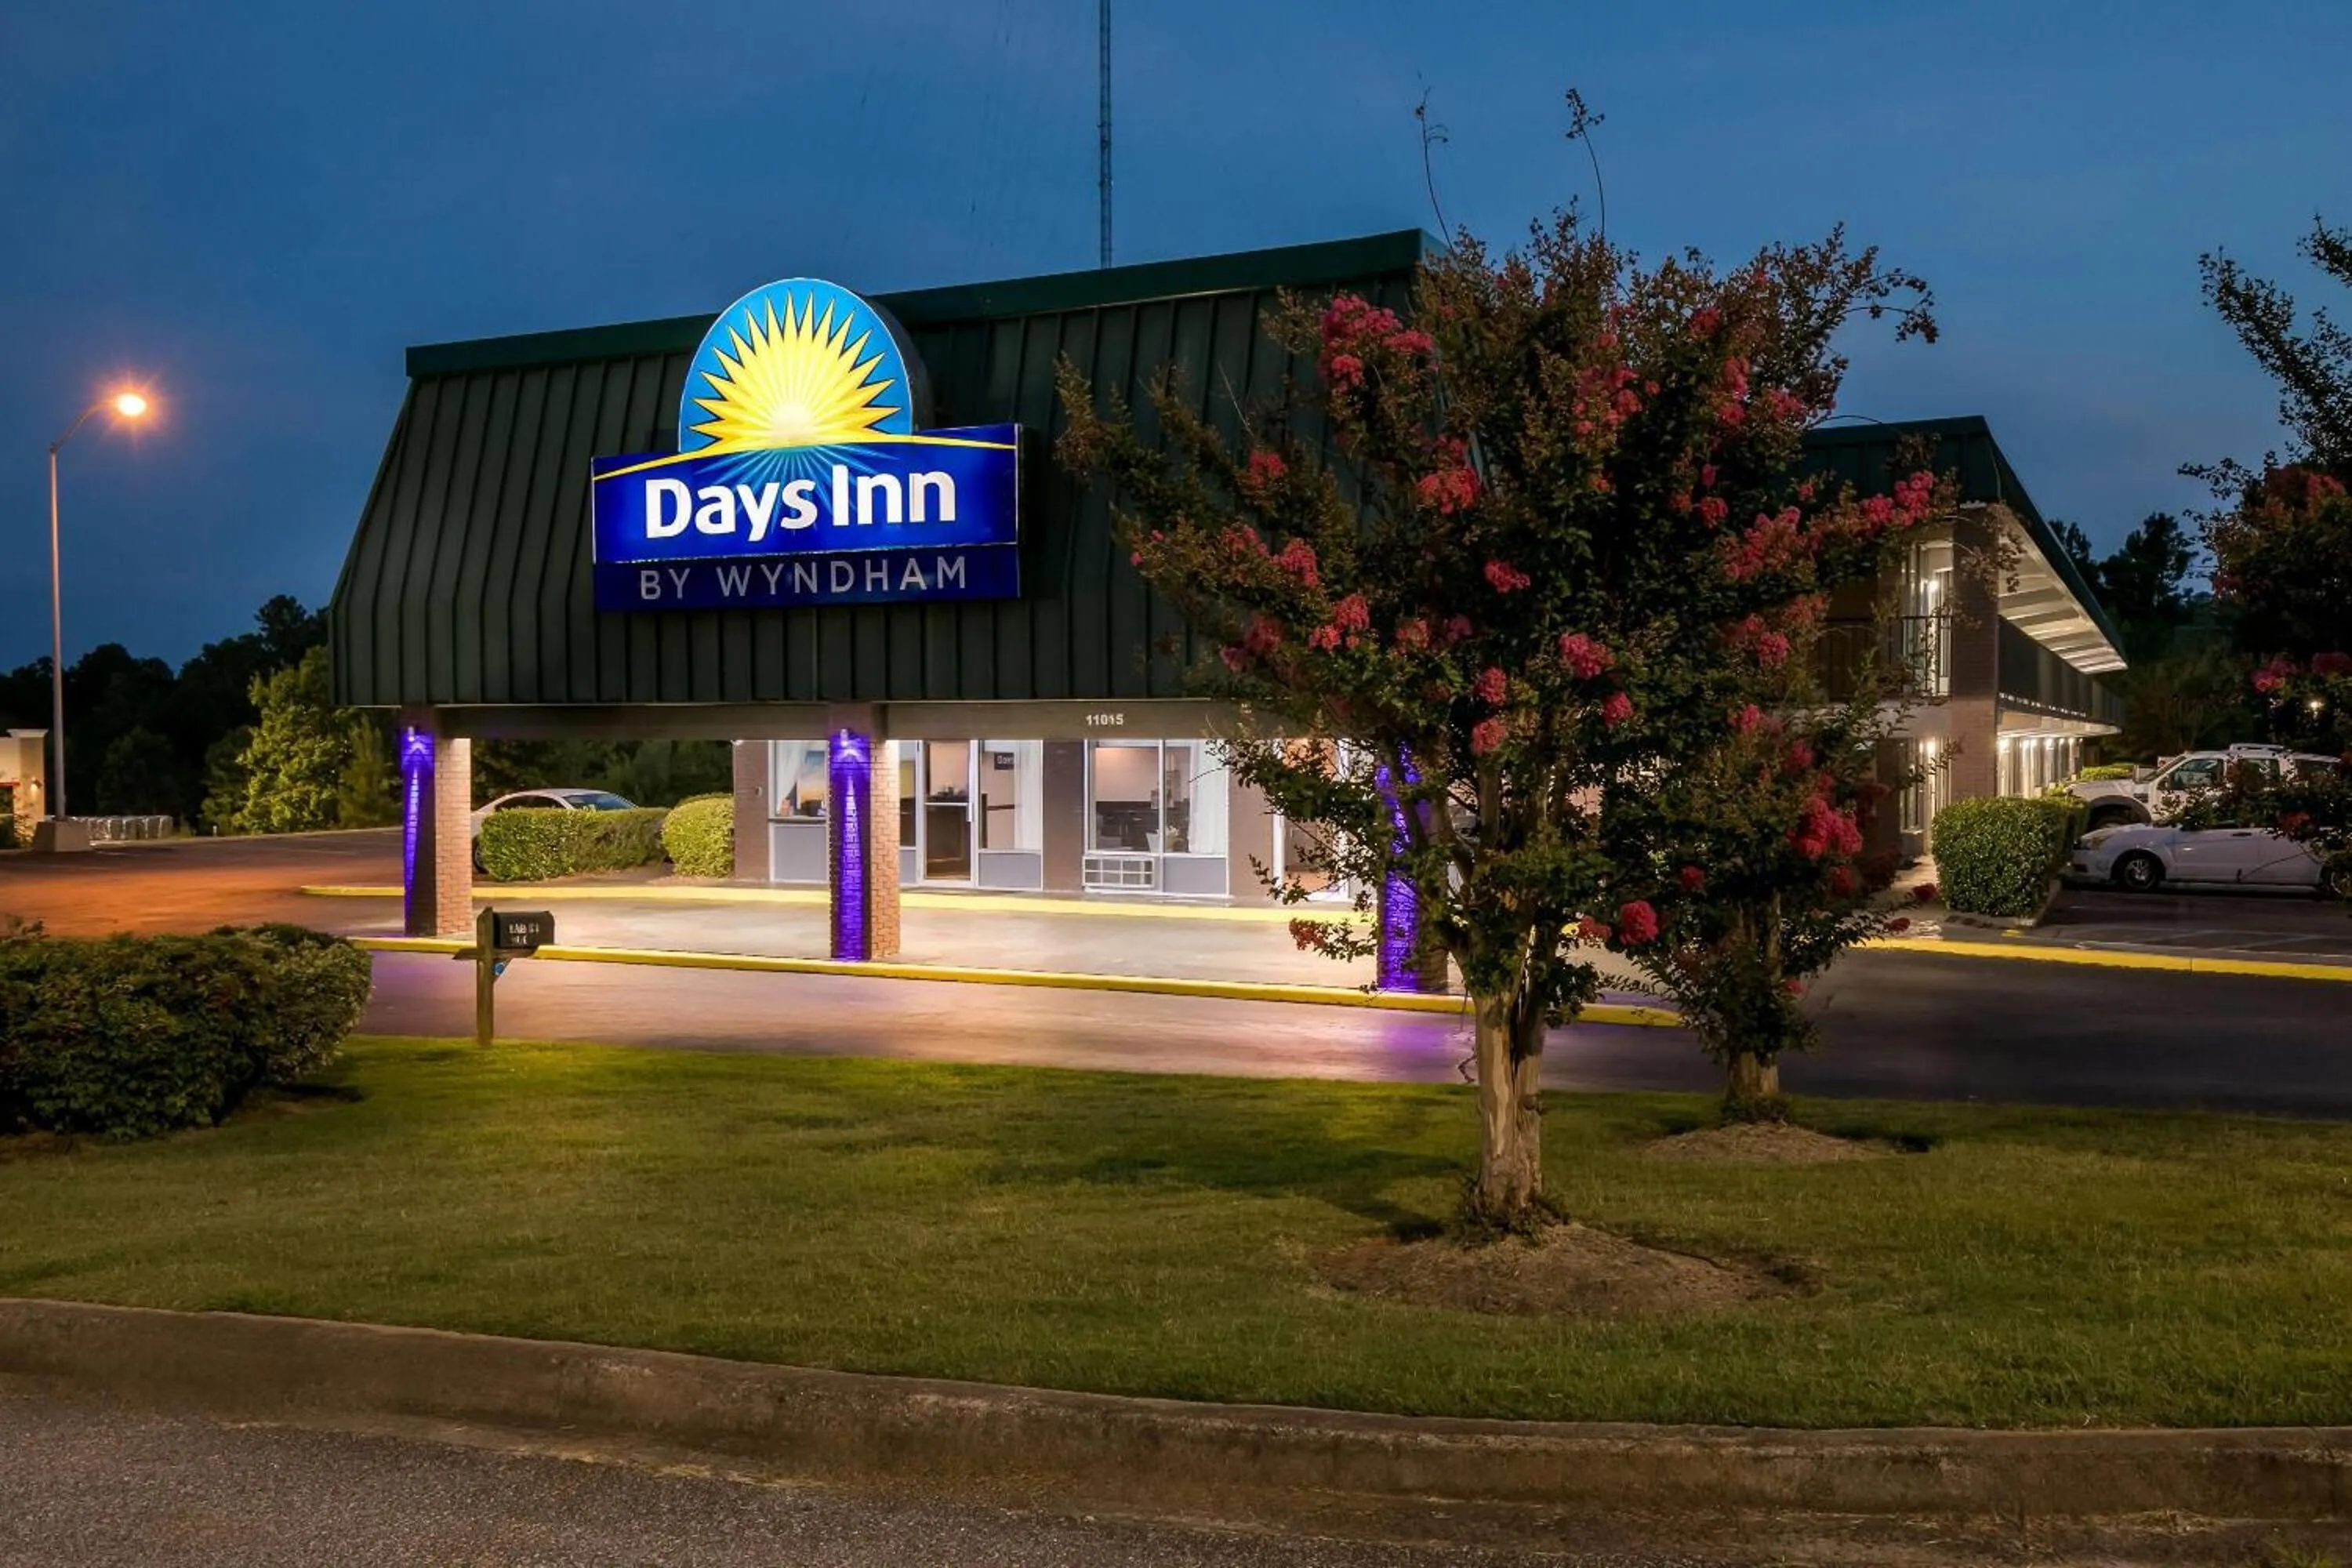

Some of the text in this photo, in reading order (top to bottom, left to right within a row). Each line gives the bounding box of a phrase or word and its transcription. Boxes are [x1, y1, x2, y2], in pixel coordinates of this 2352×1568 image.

[644, 464, 956, 542] Days Inn
[640, 556, 967, 601] BY WYNDHAM
[1086, 713, 1124, 726] 11015
